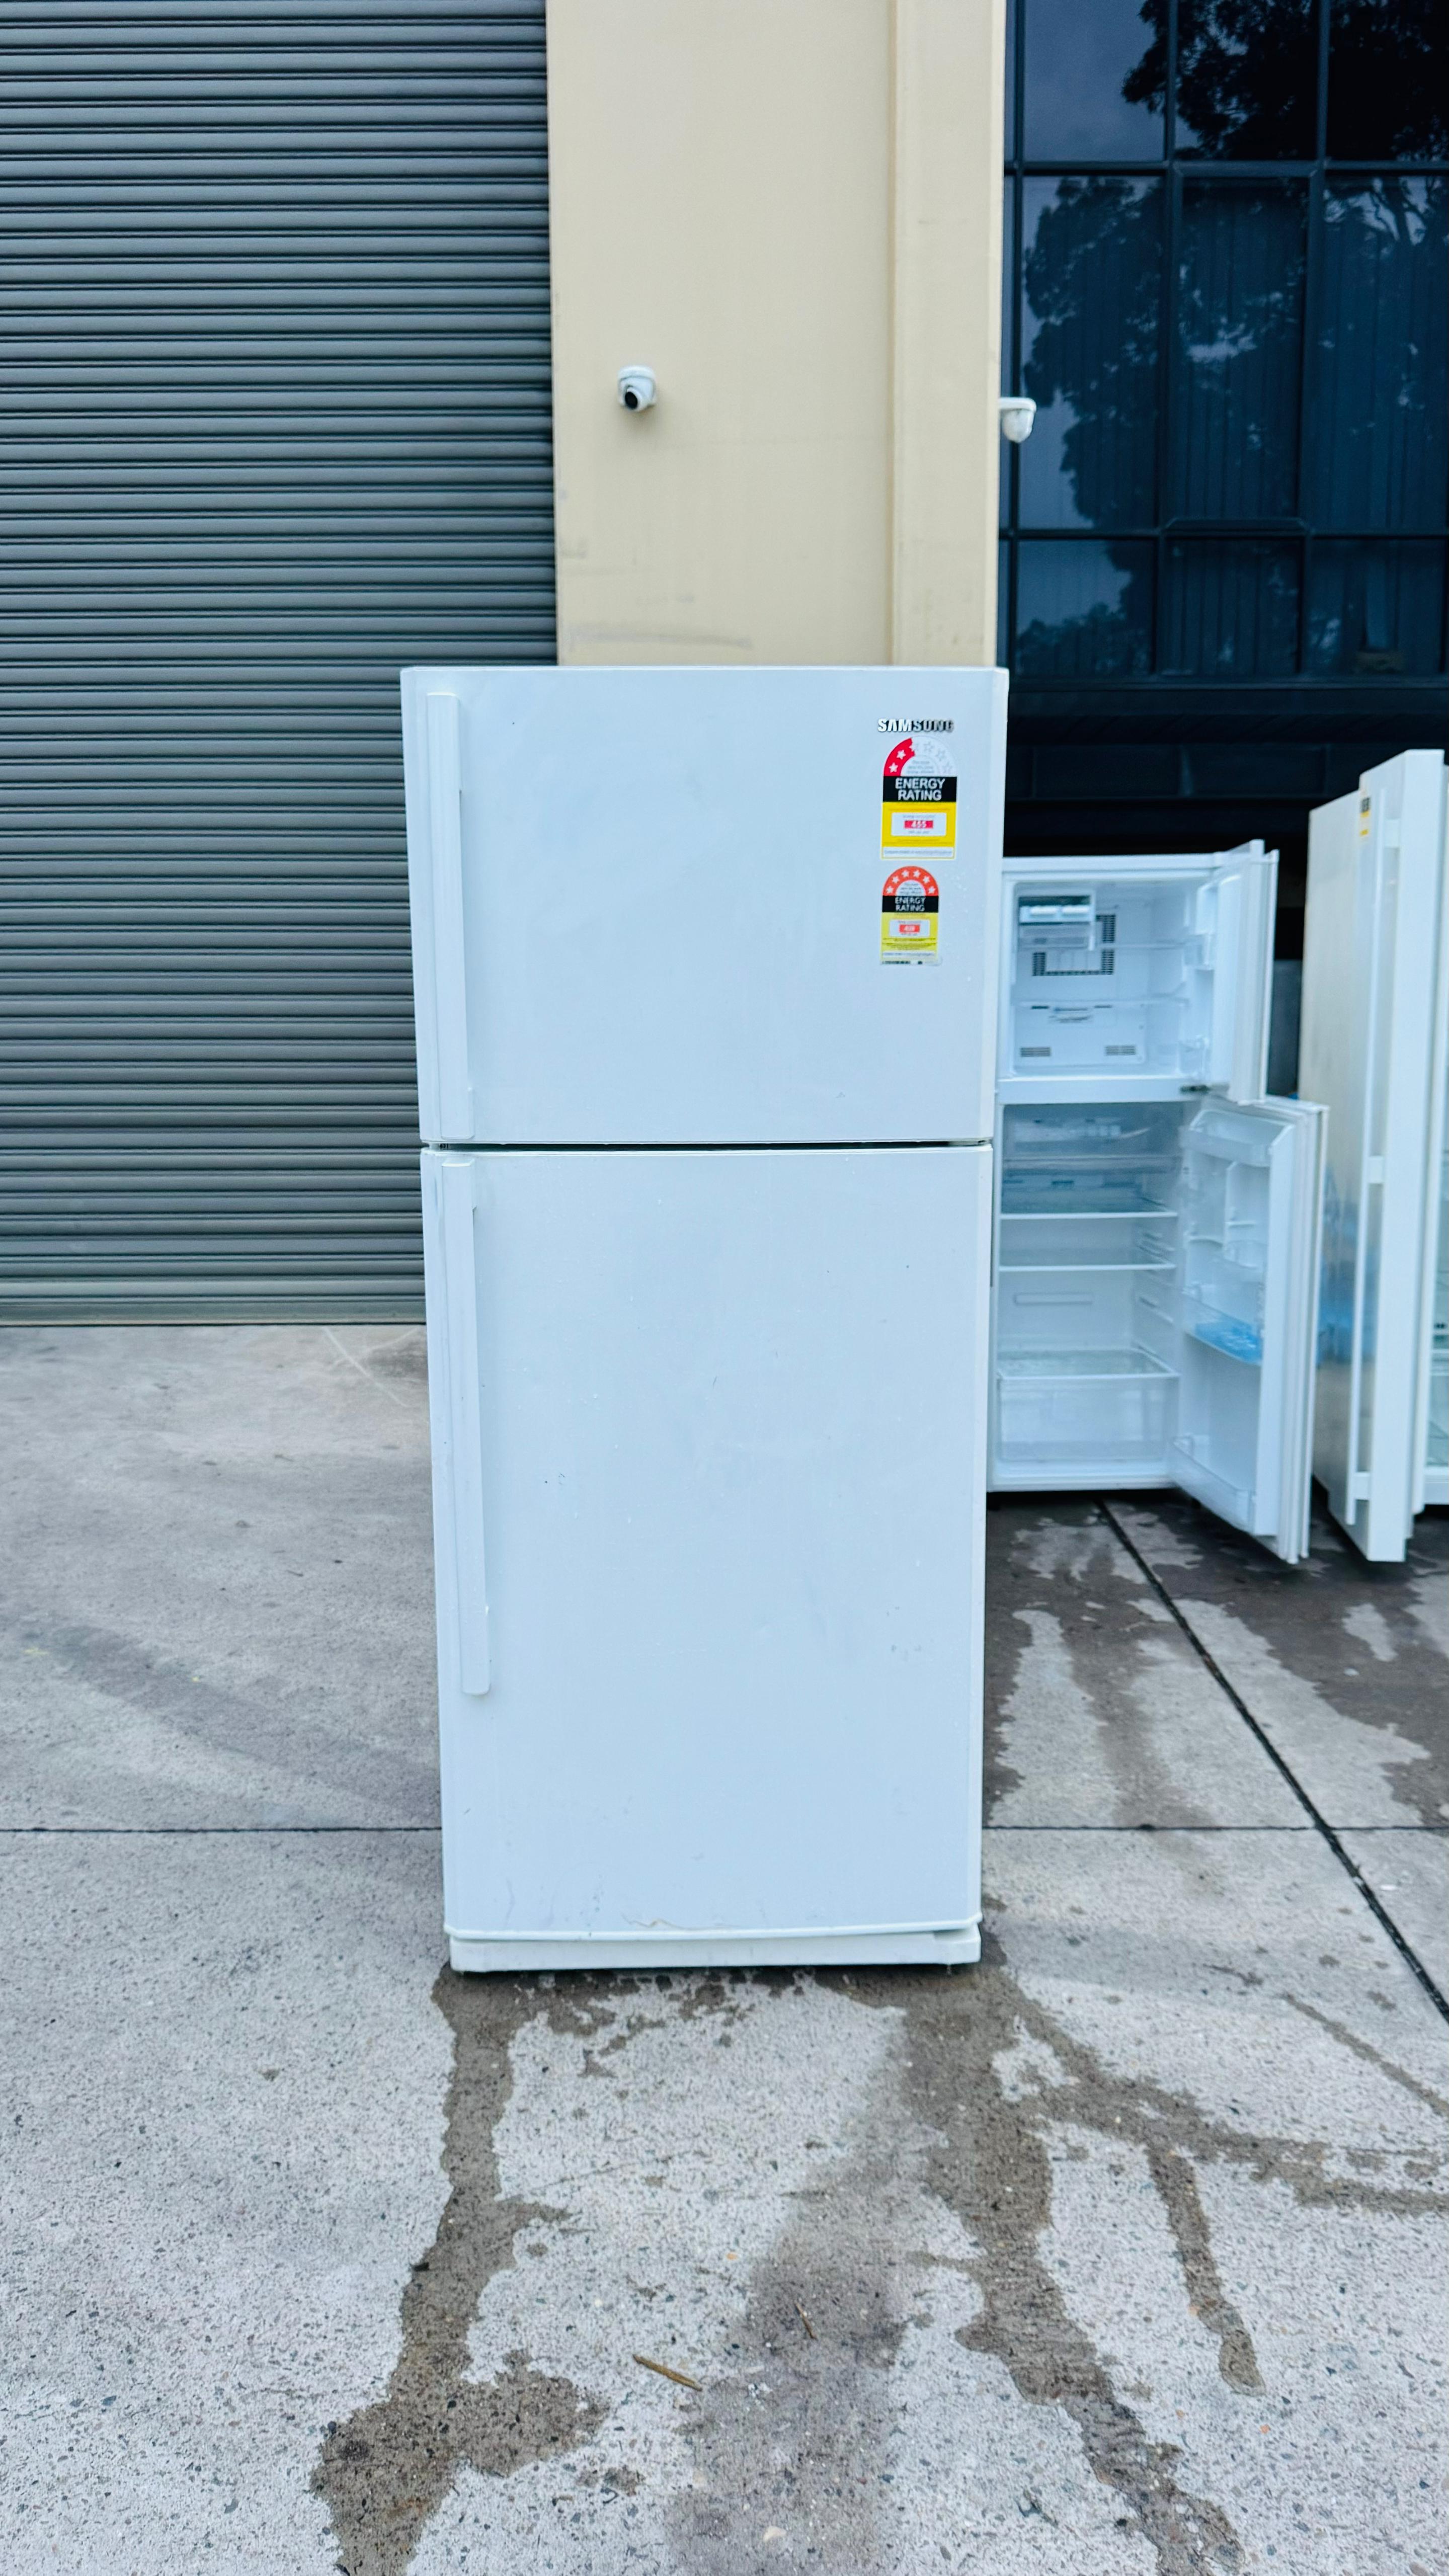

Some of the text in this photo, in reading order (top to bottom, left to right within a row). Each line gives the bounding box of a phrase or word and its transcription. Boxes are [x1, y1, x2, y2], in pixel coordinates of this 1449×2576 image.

[877, 718, 954, 733] SAMSUNG
[895, 778, 945, 789] ENERGY
[898, 789, 942, 801] RATING
